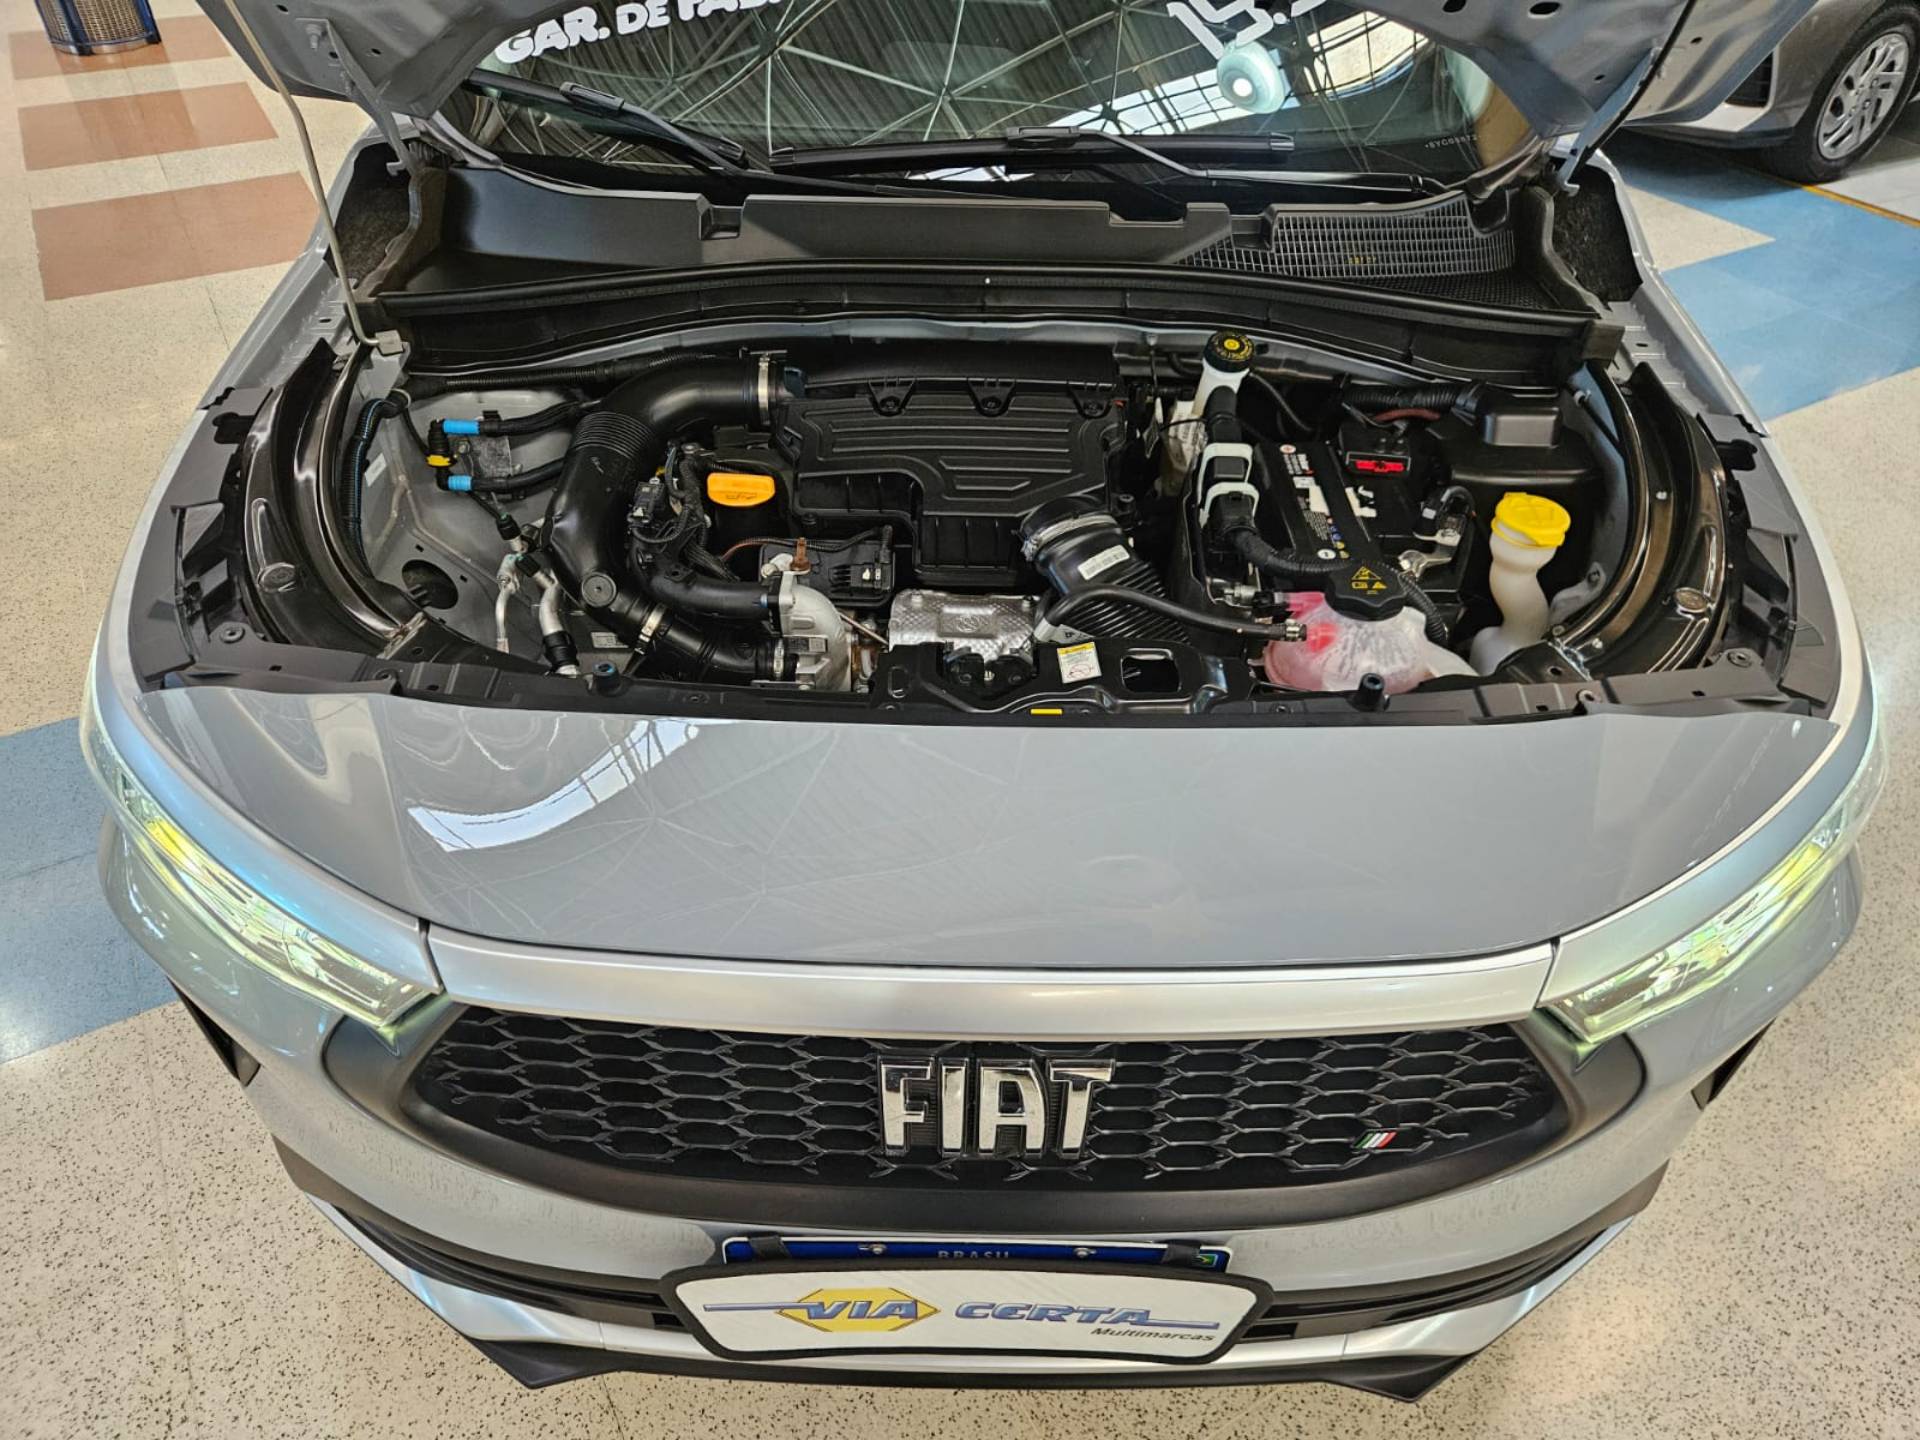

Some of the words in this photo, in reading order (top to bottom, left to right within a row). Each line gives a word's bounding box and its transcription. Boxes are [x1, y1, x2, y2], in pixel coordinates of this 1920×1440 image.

[495, 7, 611, 63] GAR.
[616, 0, 671, 35] DE
[879, 1059, 1114, 1156] FIAT
[805, 1299, 918, 1321] VIA
[955, 1301, 1152, 1325] CERTA
[1090, 1326, 1216, 1341] Multimarcas
